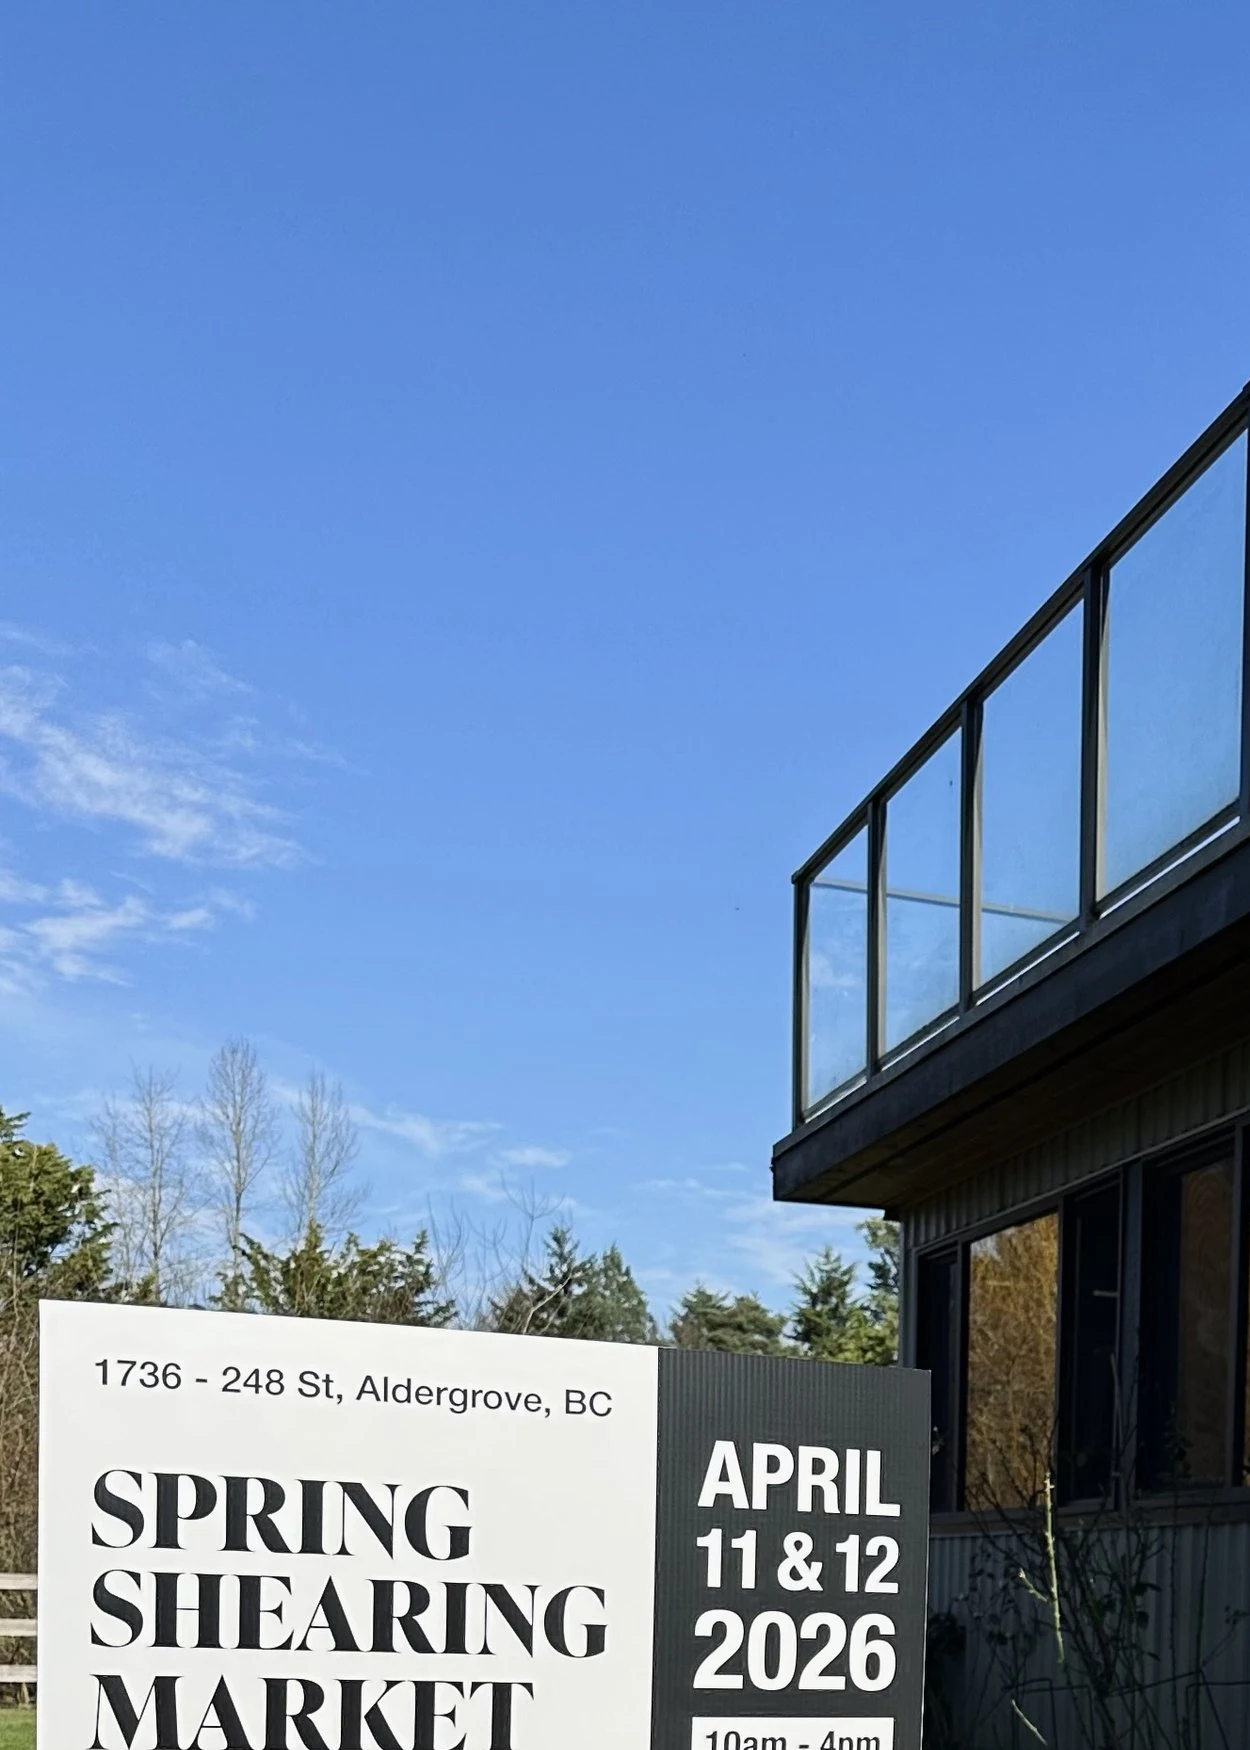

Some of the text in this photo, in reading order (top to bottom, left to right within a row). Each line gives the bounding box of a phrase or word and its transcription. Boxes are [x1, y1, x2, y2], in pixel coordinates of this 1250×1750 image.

[95, 1358, 182, 1390] 1736
[221, 1366, 285, 1396] 248
[297, 1370, 343, 1405] St,
[355, 1375, 551, 1418] Aldergrove,
[565, 1389, 612, 1417] BC
[91, 1469, 472, 1561] SPRING
[697, 1440, 901, 1517] APRIL
[696, 1528, 899, 1594] 11 & 12
[90, 1569, 608, 1659] SHEARING
[692, 1609, 896, 1692] 2026
